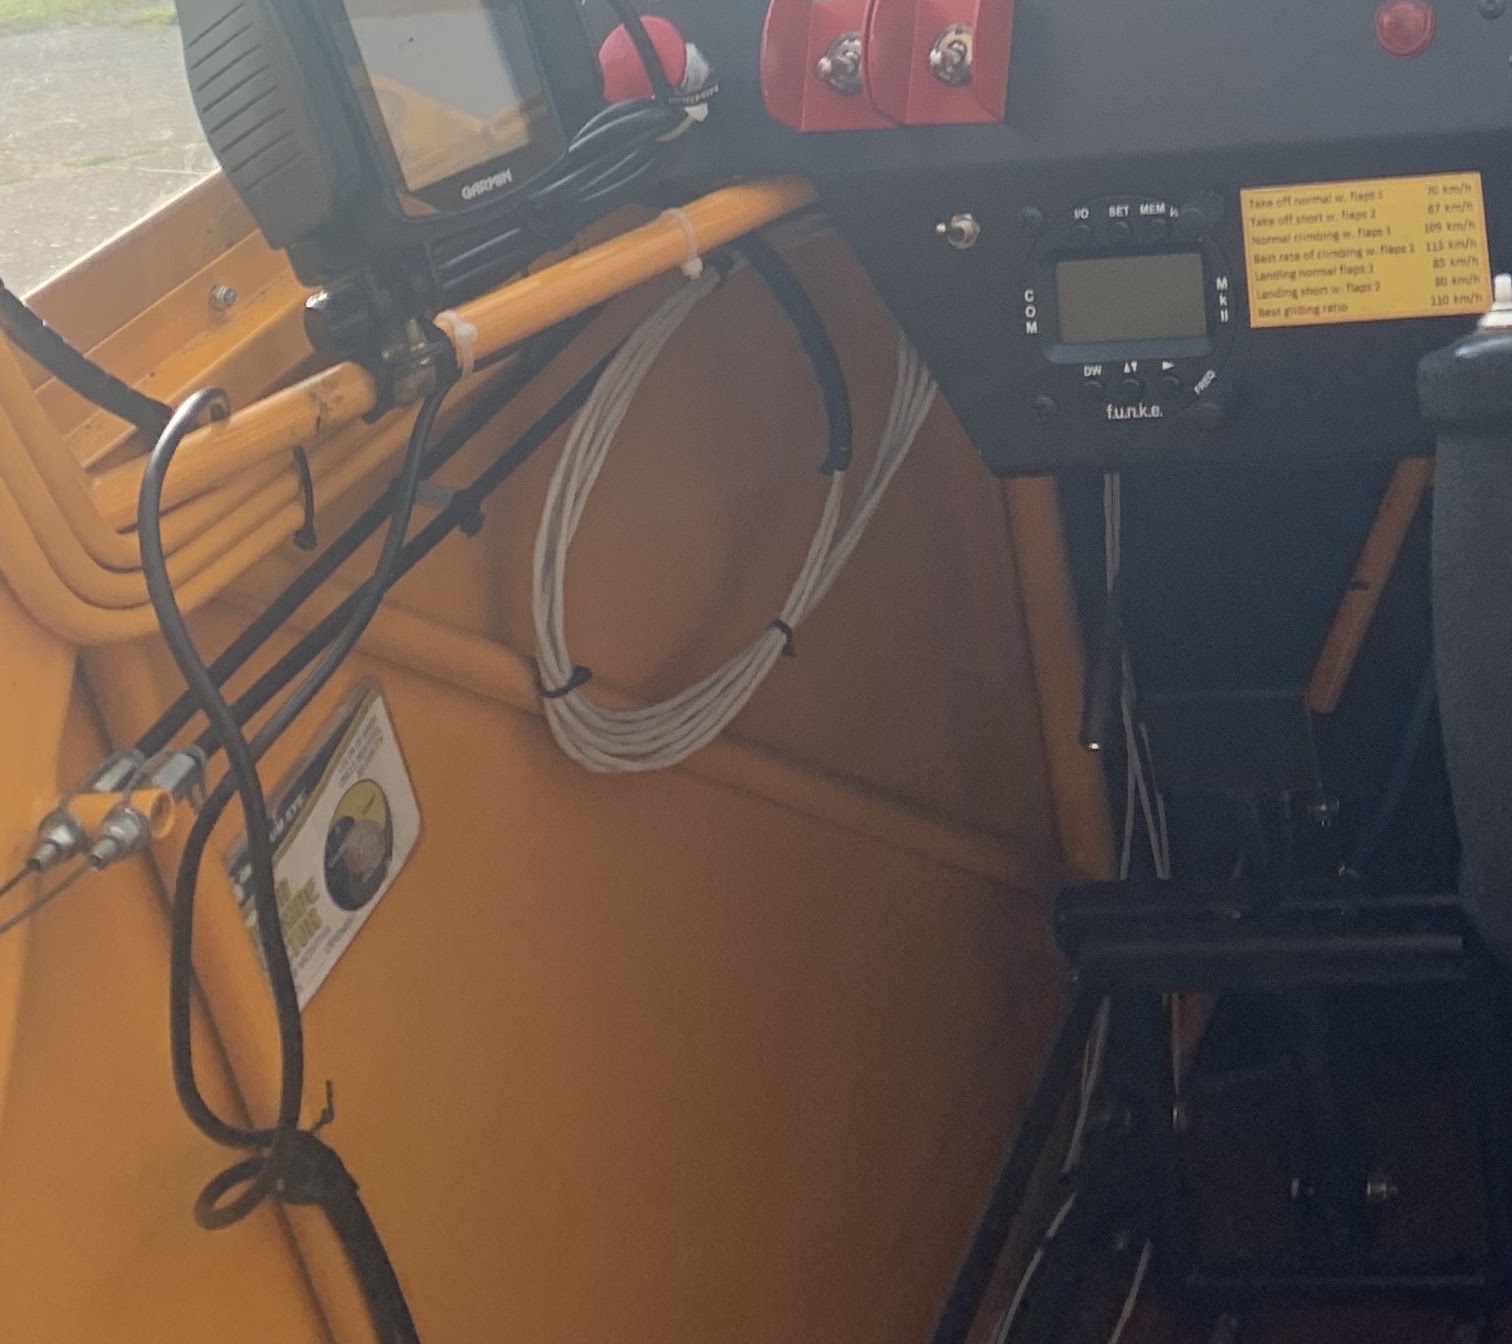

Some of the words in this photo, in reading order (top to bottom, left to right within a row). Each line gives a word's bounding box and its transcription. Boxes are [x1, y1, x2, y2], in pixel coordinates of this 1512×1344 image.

[461, 169, 513, 200] GARMIN
[1109, 205, 1130, 218] SET
[1140, 202, 1166, 215] MEM
[1084, 365, 1102, 377] DW
